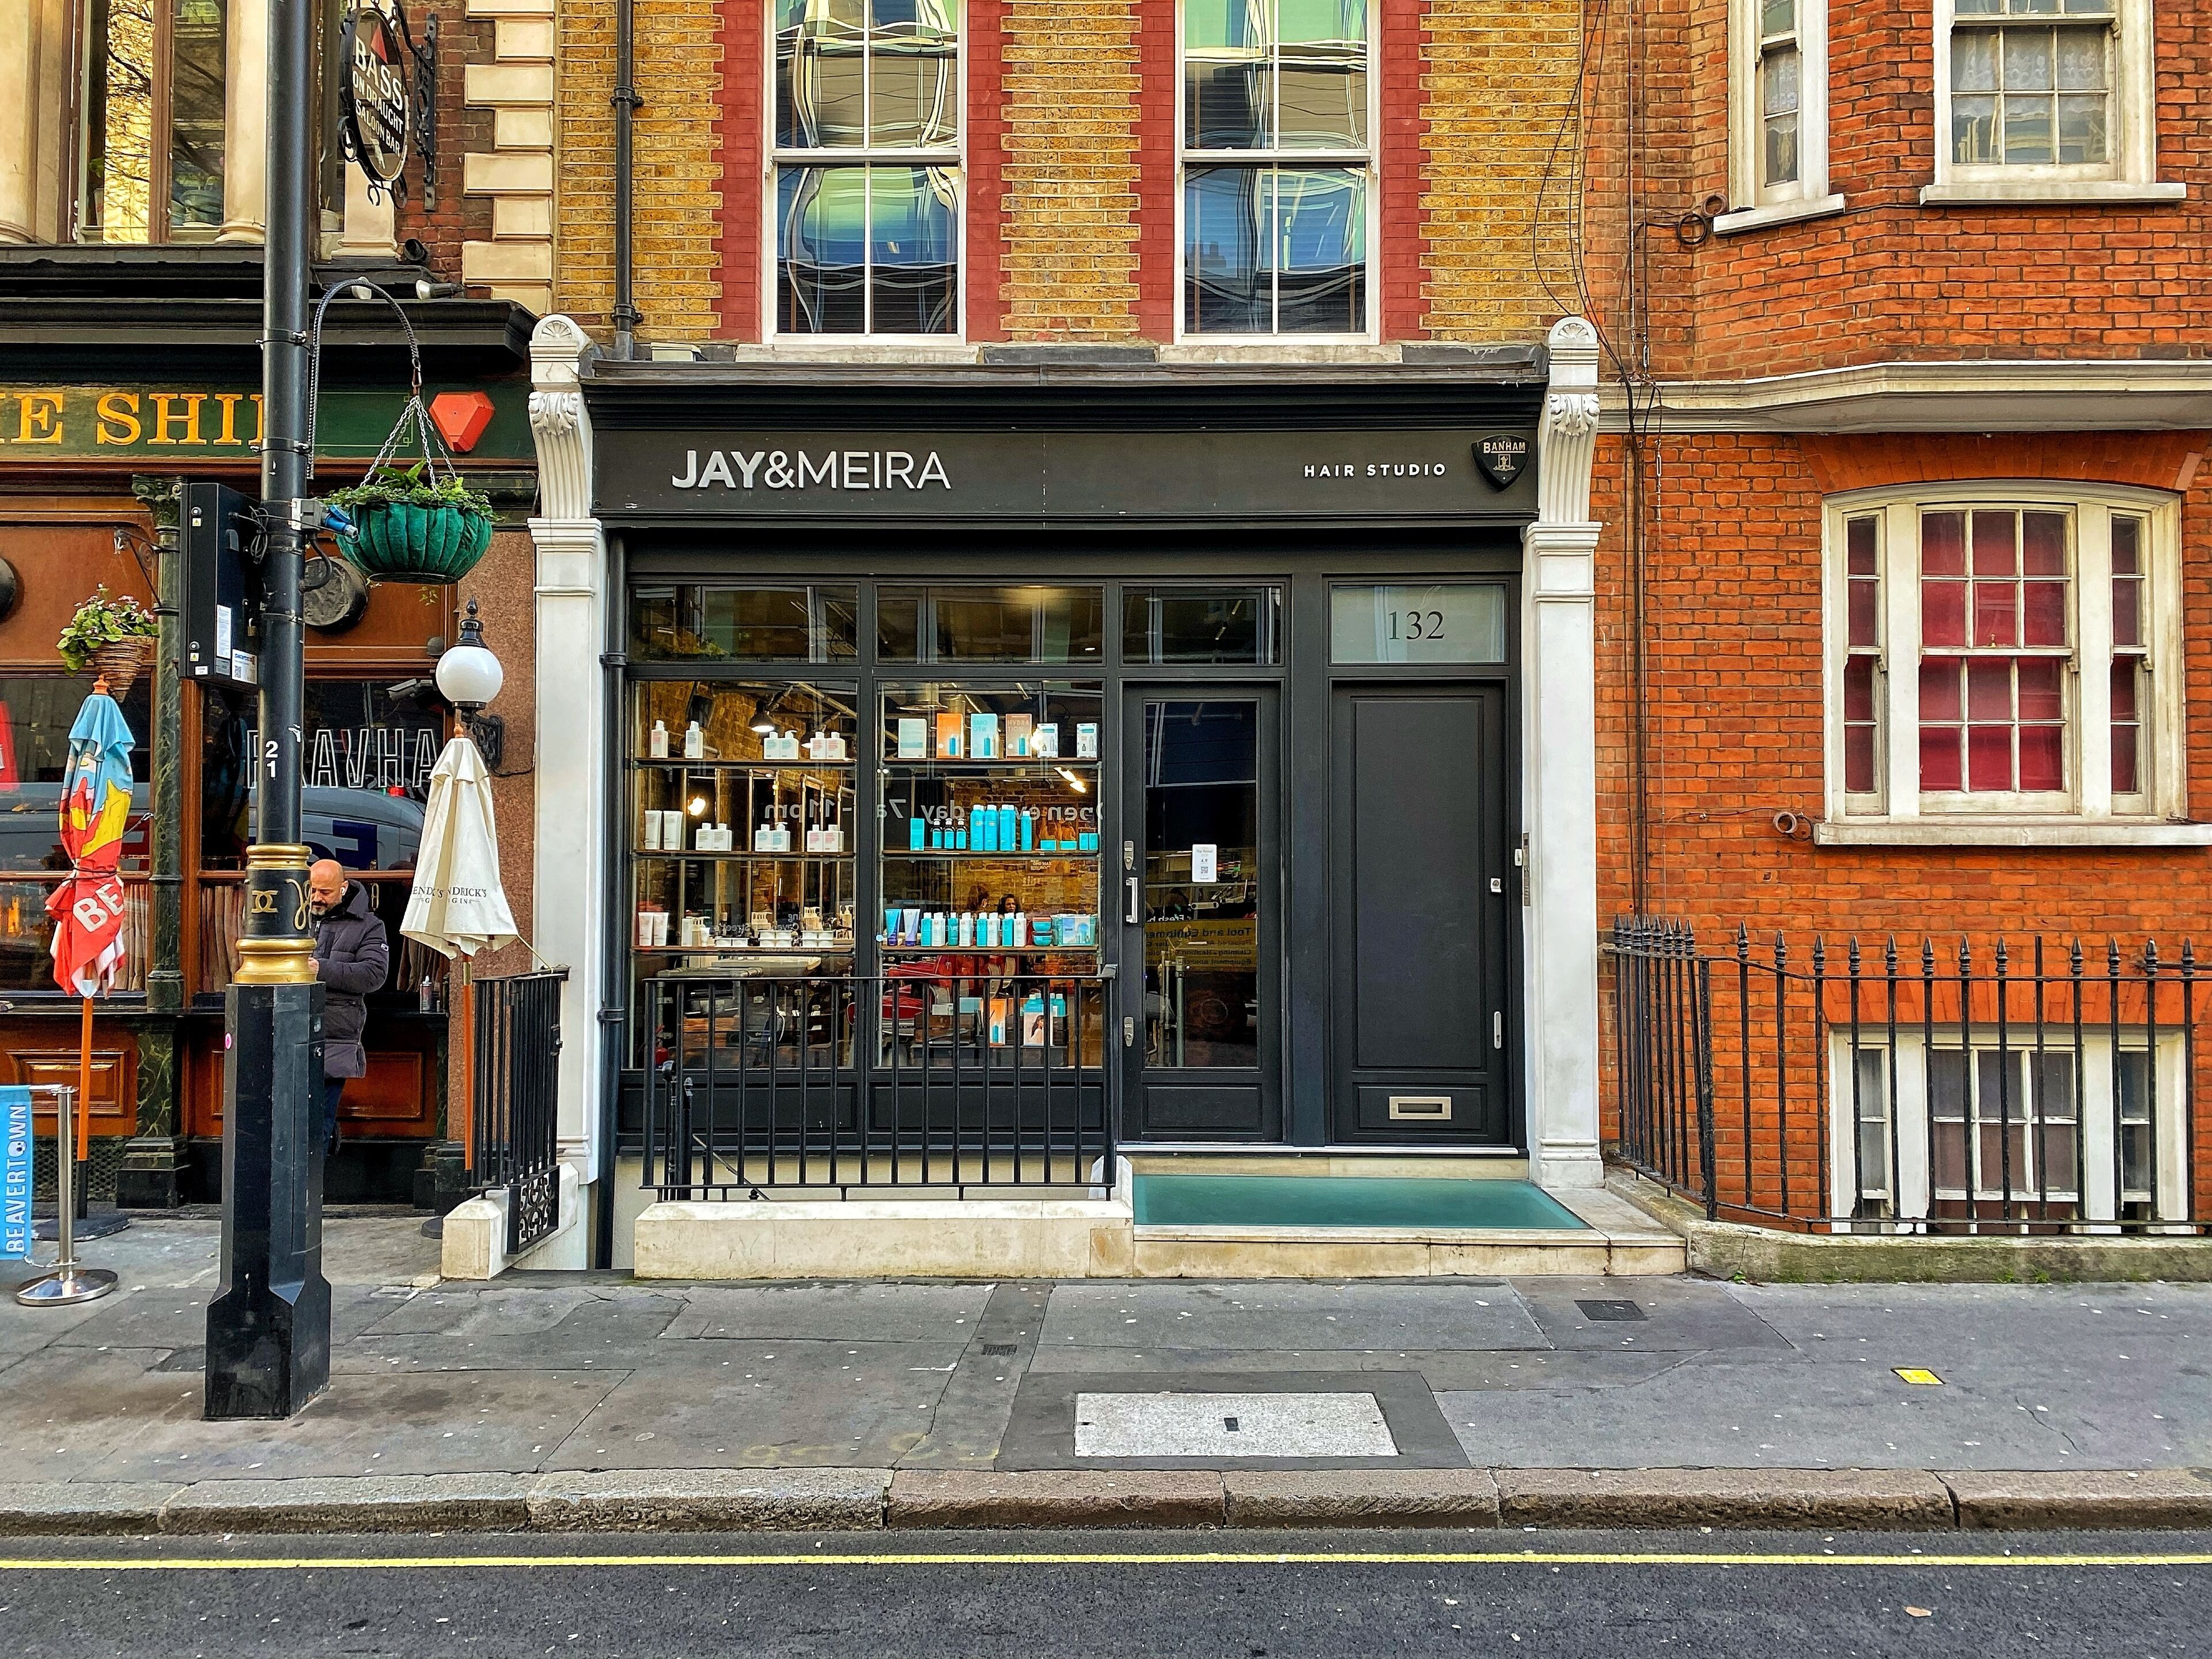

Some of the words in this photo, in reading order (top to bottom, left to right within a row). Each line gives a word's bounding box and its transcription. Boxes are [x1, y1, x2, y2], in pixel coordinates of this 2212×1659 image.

[355, 35, 403, 111] BASS
[353, 70, 365, 96] ON
[366, 84, 403, 135] DRAUGHT
[355, 99, 385, 140] SALOON
[386, 128, 400, 157] BAR
[0, 393, 63, 444] E
[672, 450, 952, 489] JAY&MEIRA
[1483, 441, 1525, 454] BANHAM
[1304, 464, 1354, 478] HAIR
[1366, 463, 1446, 477] STUDIO
[1388, 611, 1445, 640] 132
[247, 729, 437, 788] AVHA
[448, 887, 487, 898] NDRICK'S
